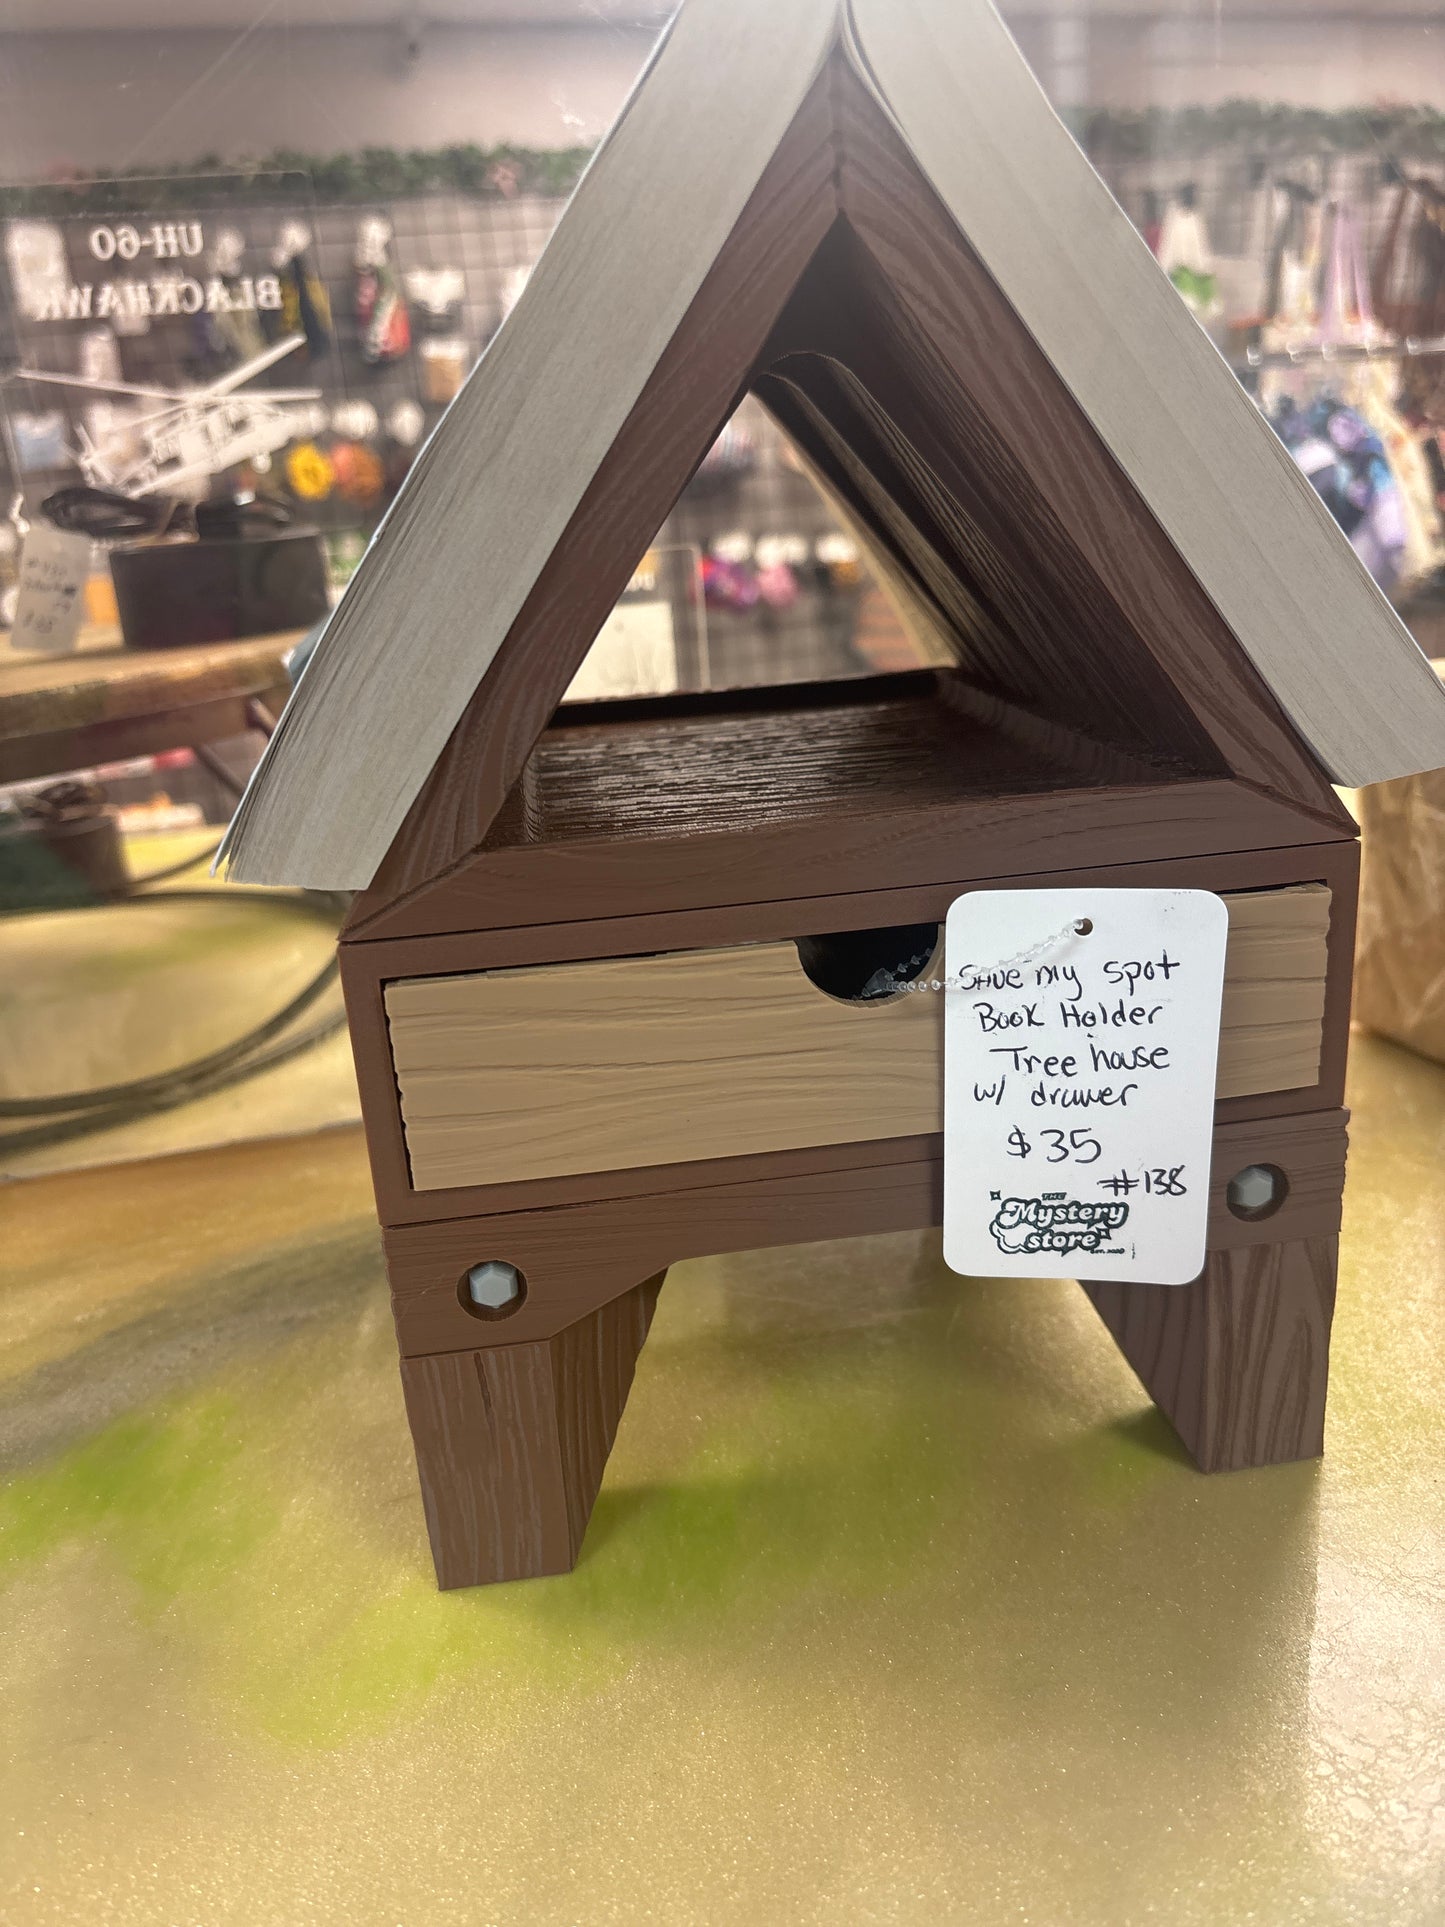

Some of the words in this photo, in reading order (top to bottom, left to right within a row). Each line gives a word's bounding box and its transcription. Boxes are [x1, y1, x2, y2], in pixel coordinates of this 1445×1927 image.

[1035, 964, 1082, 1001] my
[1060, 999, 1163, 1028] Holder
[989, 1046, 1078, 1077] Tree
[1030, 1080, 1138, 1108] drawer
[1097, 1164, 1188, 1196] #138
[998, 1200, 1127, 1228] Mystery
